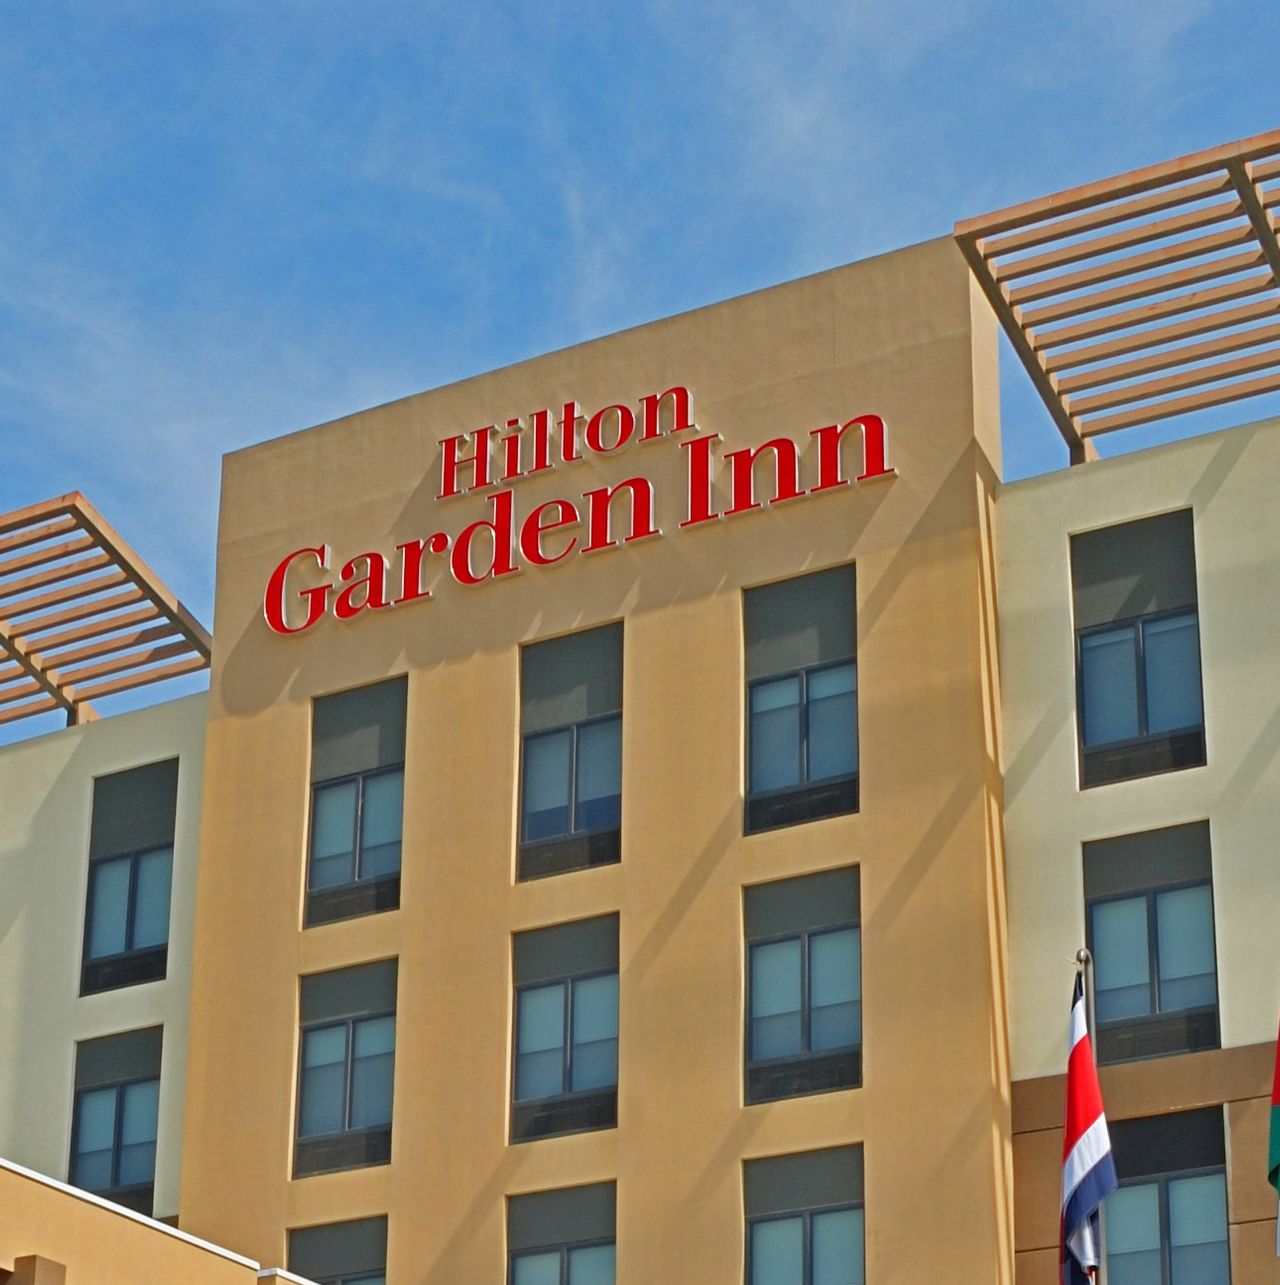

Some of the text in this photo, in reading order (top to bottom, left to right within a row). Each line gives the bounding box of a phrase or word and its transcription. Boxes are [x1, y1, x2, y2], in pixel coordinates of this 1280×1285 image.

[263, 413, 899, 636] Garden Inn
[435, 385, 700, 500] Hilton
